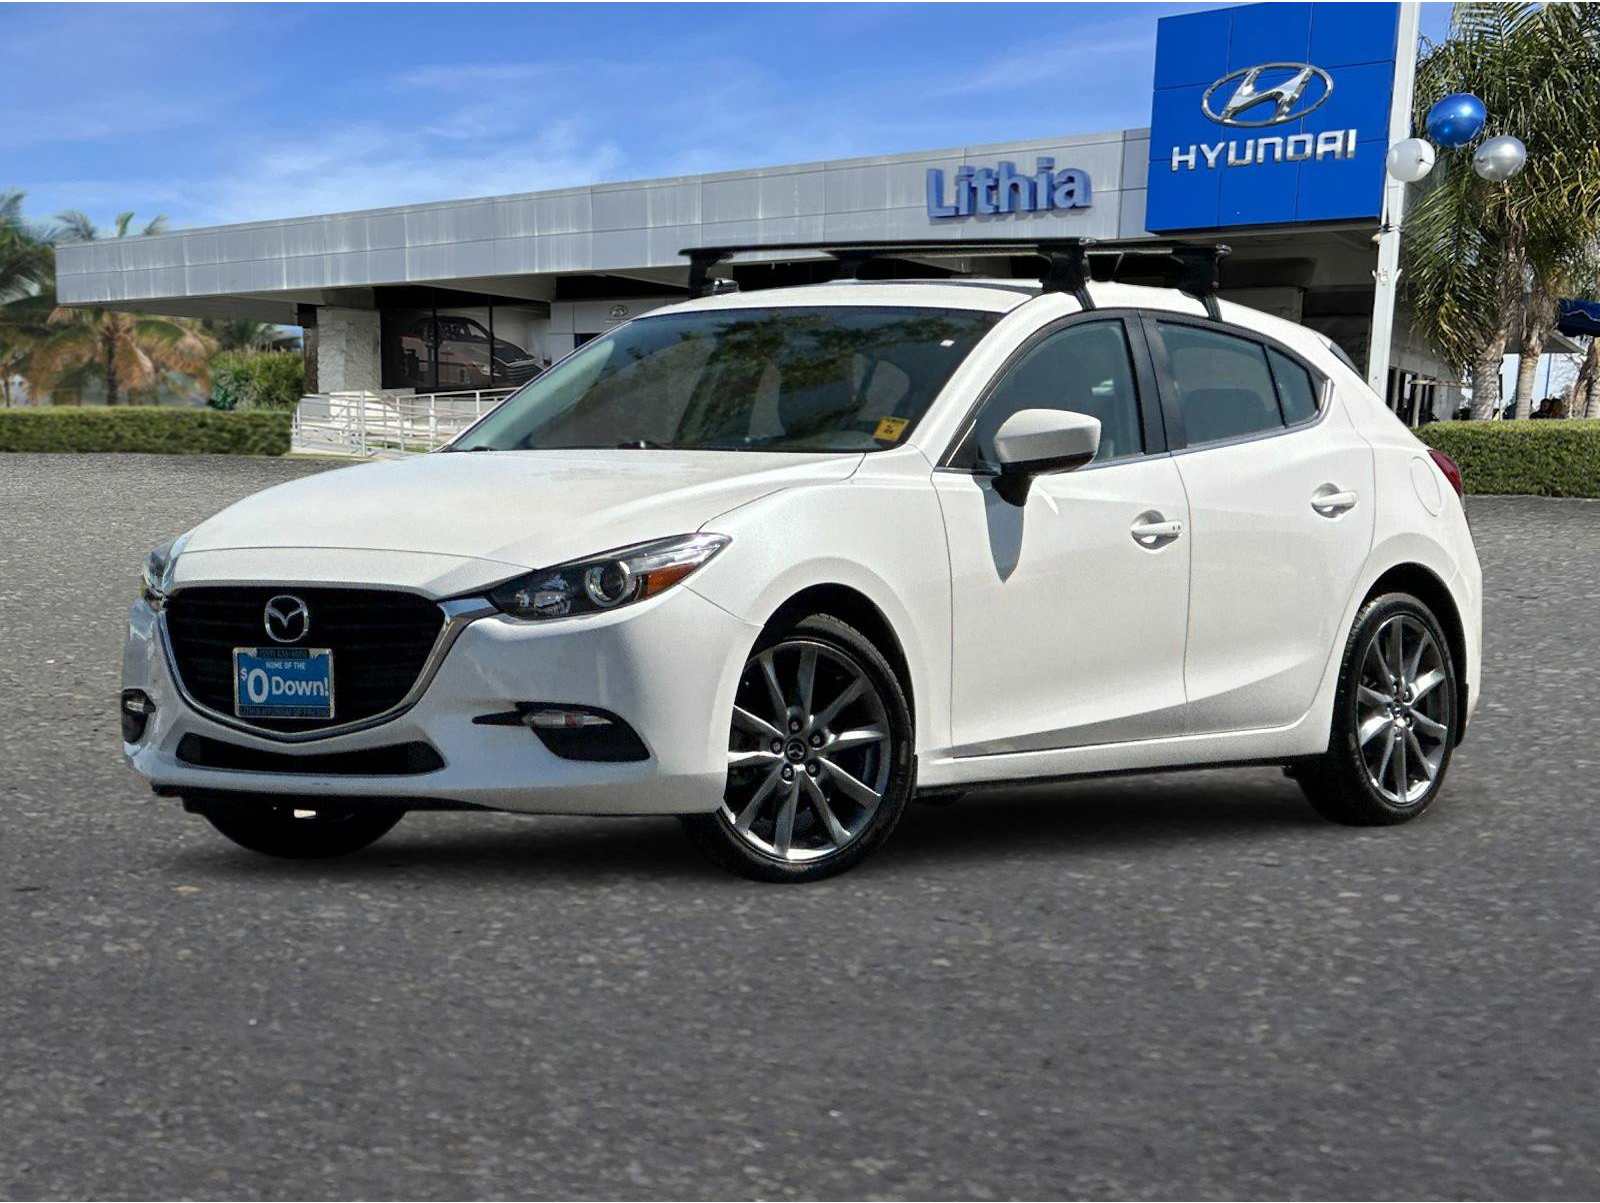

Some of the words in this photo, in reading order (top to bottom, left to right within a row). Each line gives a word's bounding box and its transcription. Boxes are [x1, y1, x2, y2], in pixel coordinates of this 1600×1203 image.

[1171, 129, 1357, 172] HYUNDAI
[927, 157, 1092, 219] Lithia
[293, 662, 306, 671] THE
[271, 676, 330, 697] Down!
